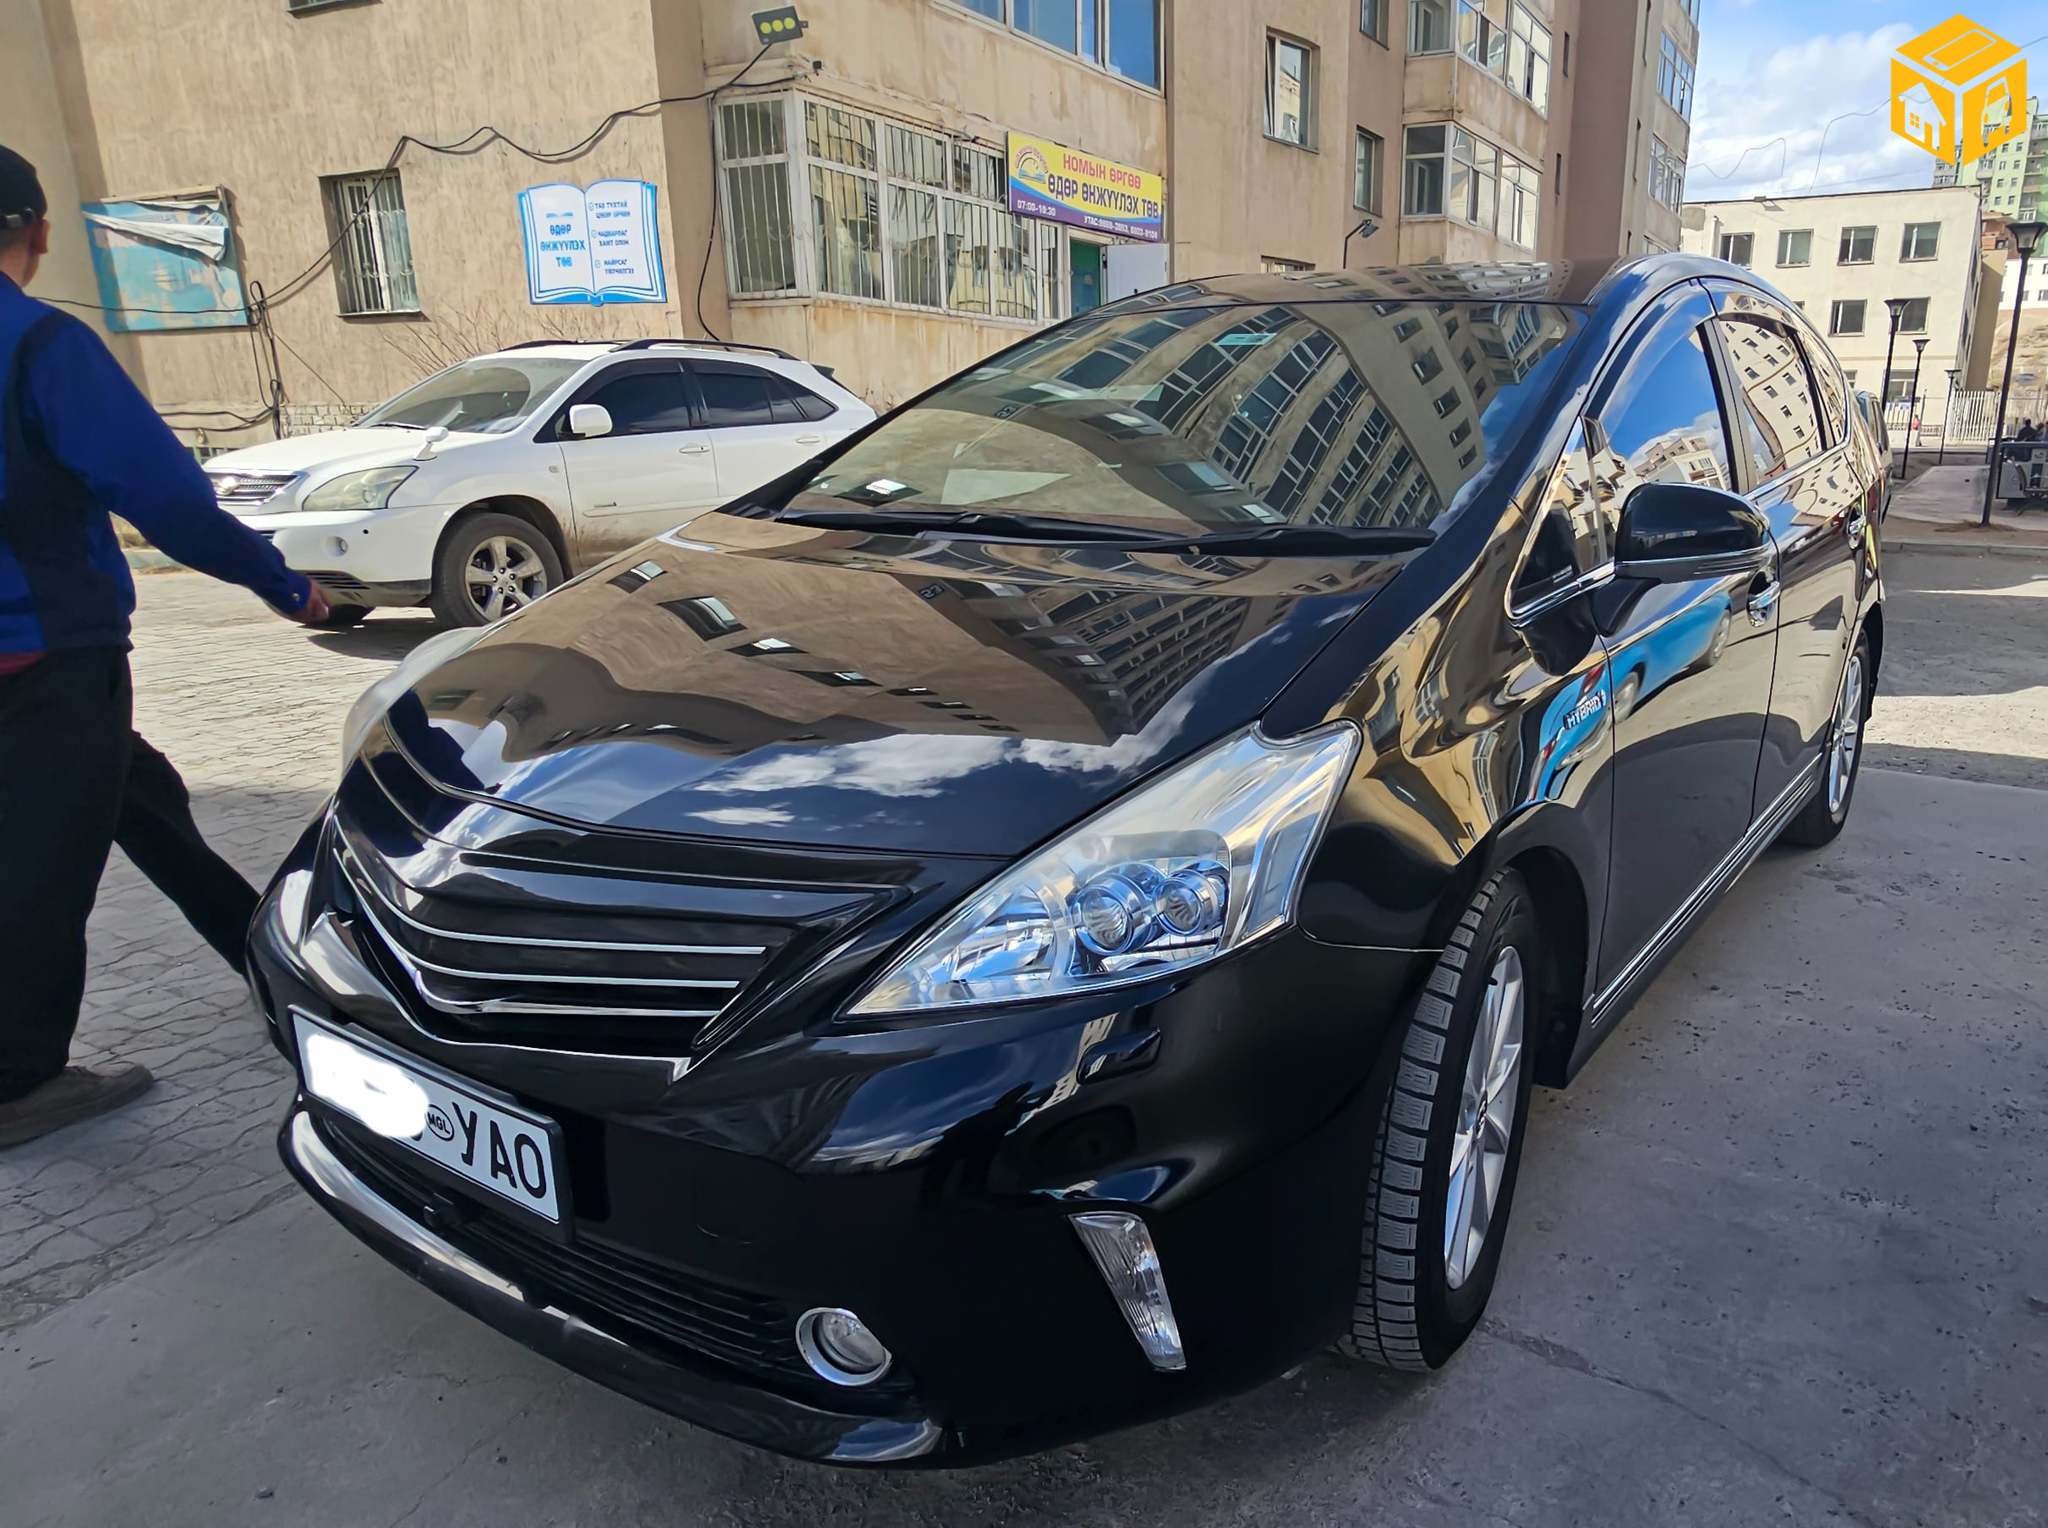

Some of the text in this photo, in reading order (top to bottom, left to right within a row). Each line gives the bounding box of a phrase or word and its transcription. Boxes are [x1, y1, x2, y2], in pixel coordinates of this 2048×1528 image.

[1063, 153, 1106, 179] НОМЫН
[1109, 169, 1142, 189] ӨРГӨӨ
[1047, 173, 1078, 201] ӨДӨР
[1142, 198, 1159, 218] ТӨВ
[1566, 693, 1602, 728] HYBRID
[427, 1109, 450, 1134] MGL
